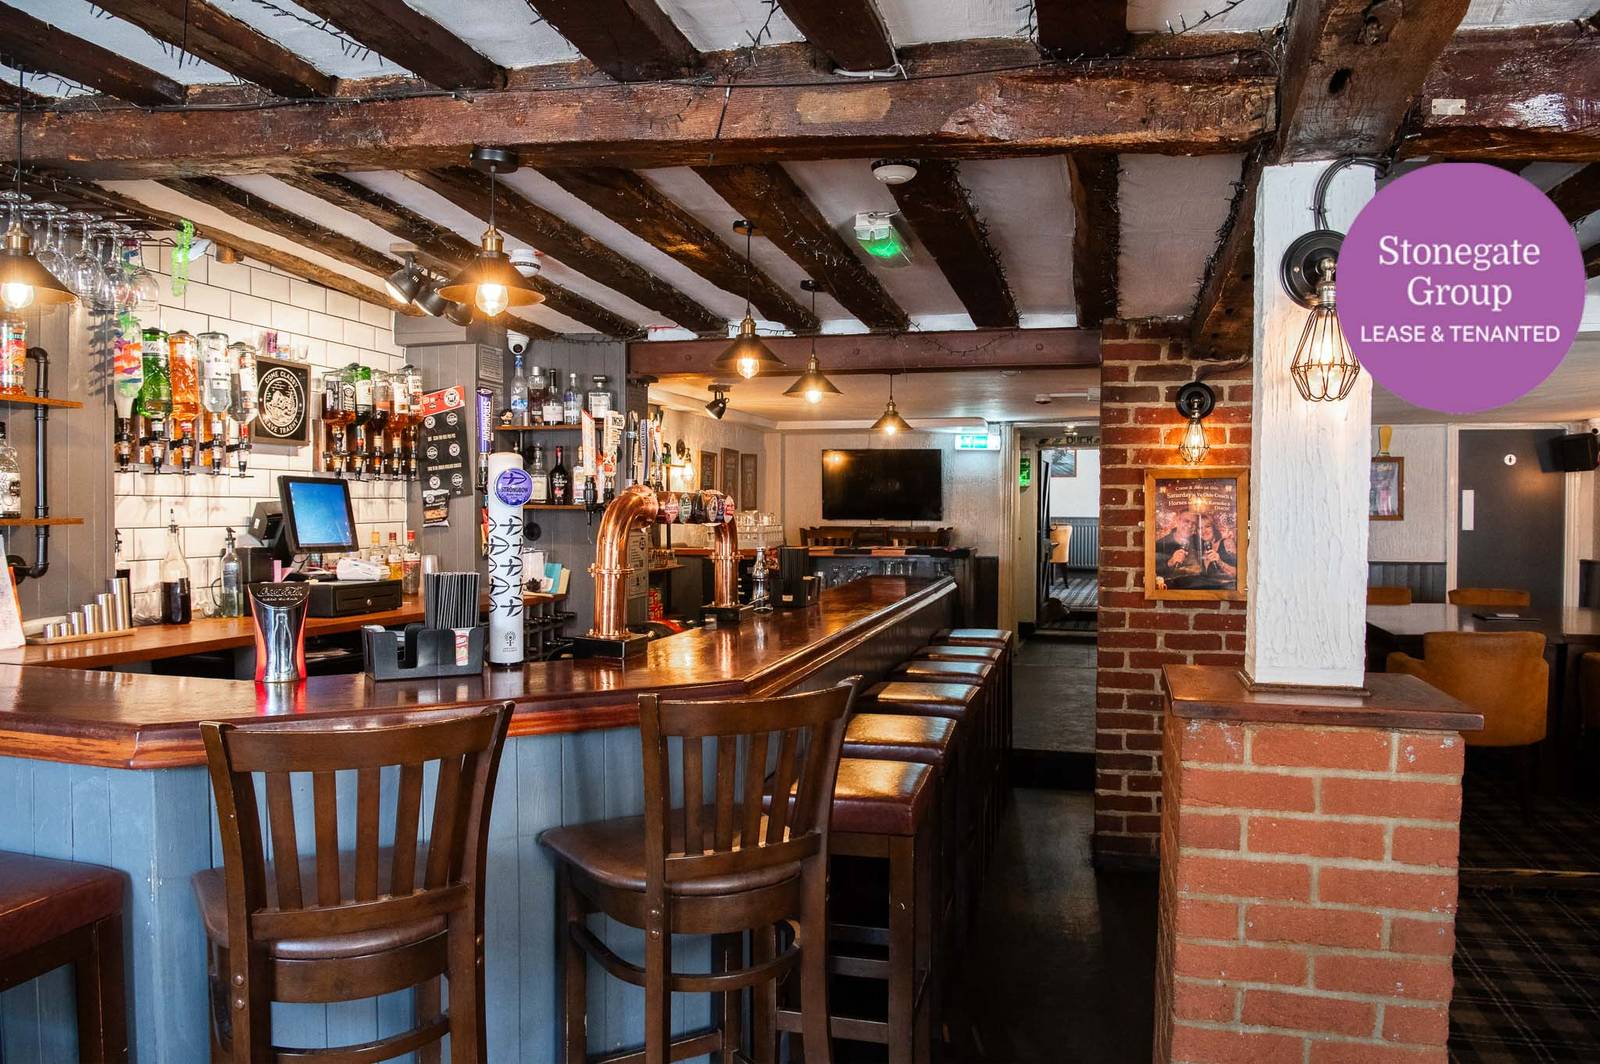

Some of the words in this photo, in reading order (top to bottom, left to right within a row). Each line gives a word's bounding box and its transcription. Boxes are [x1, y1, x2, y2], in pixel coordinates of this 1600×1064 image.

[264, 371, 279, 384] COME
[280, 371, 299, 388] CLASSY
[280, 418, 299, 434] TRASHY
[482, 401, 491, 441] STRONGBOW
[1066, 436, 1093, 445] DUCK
